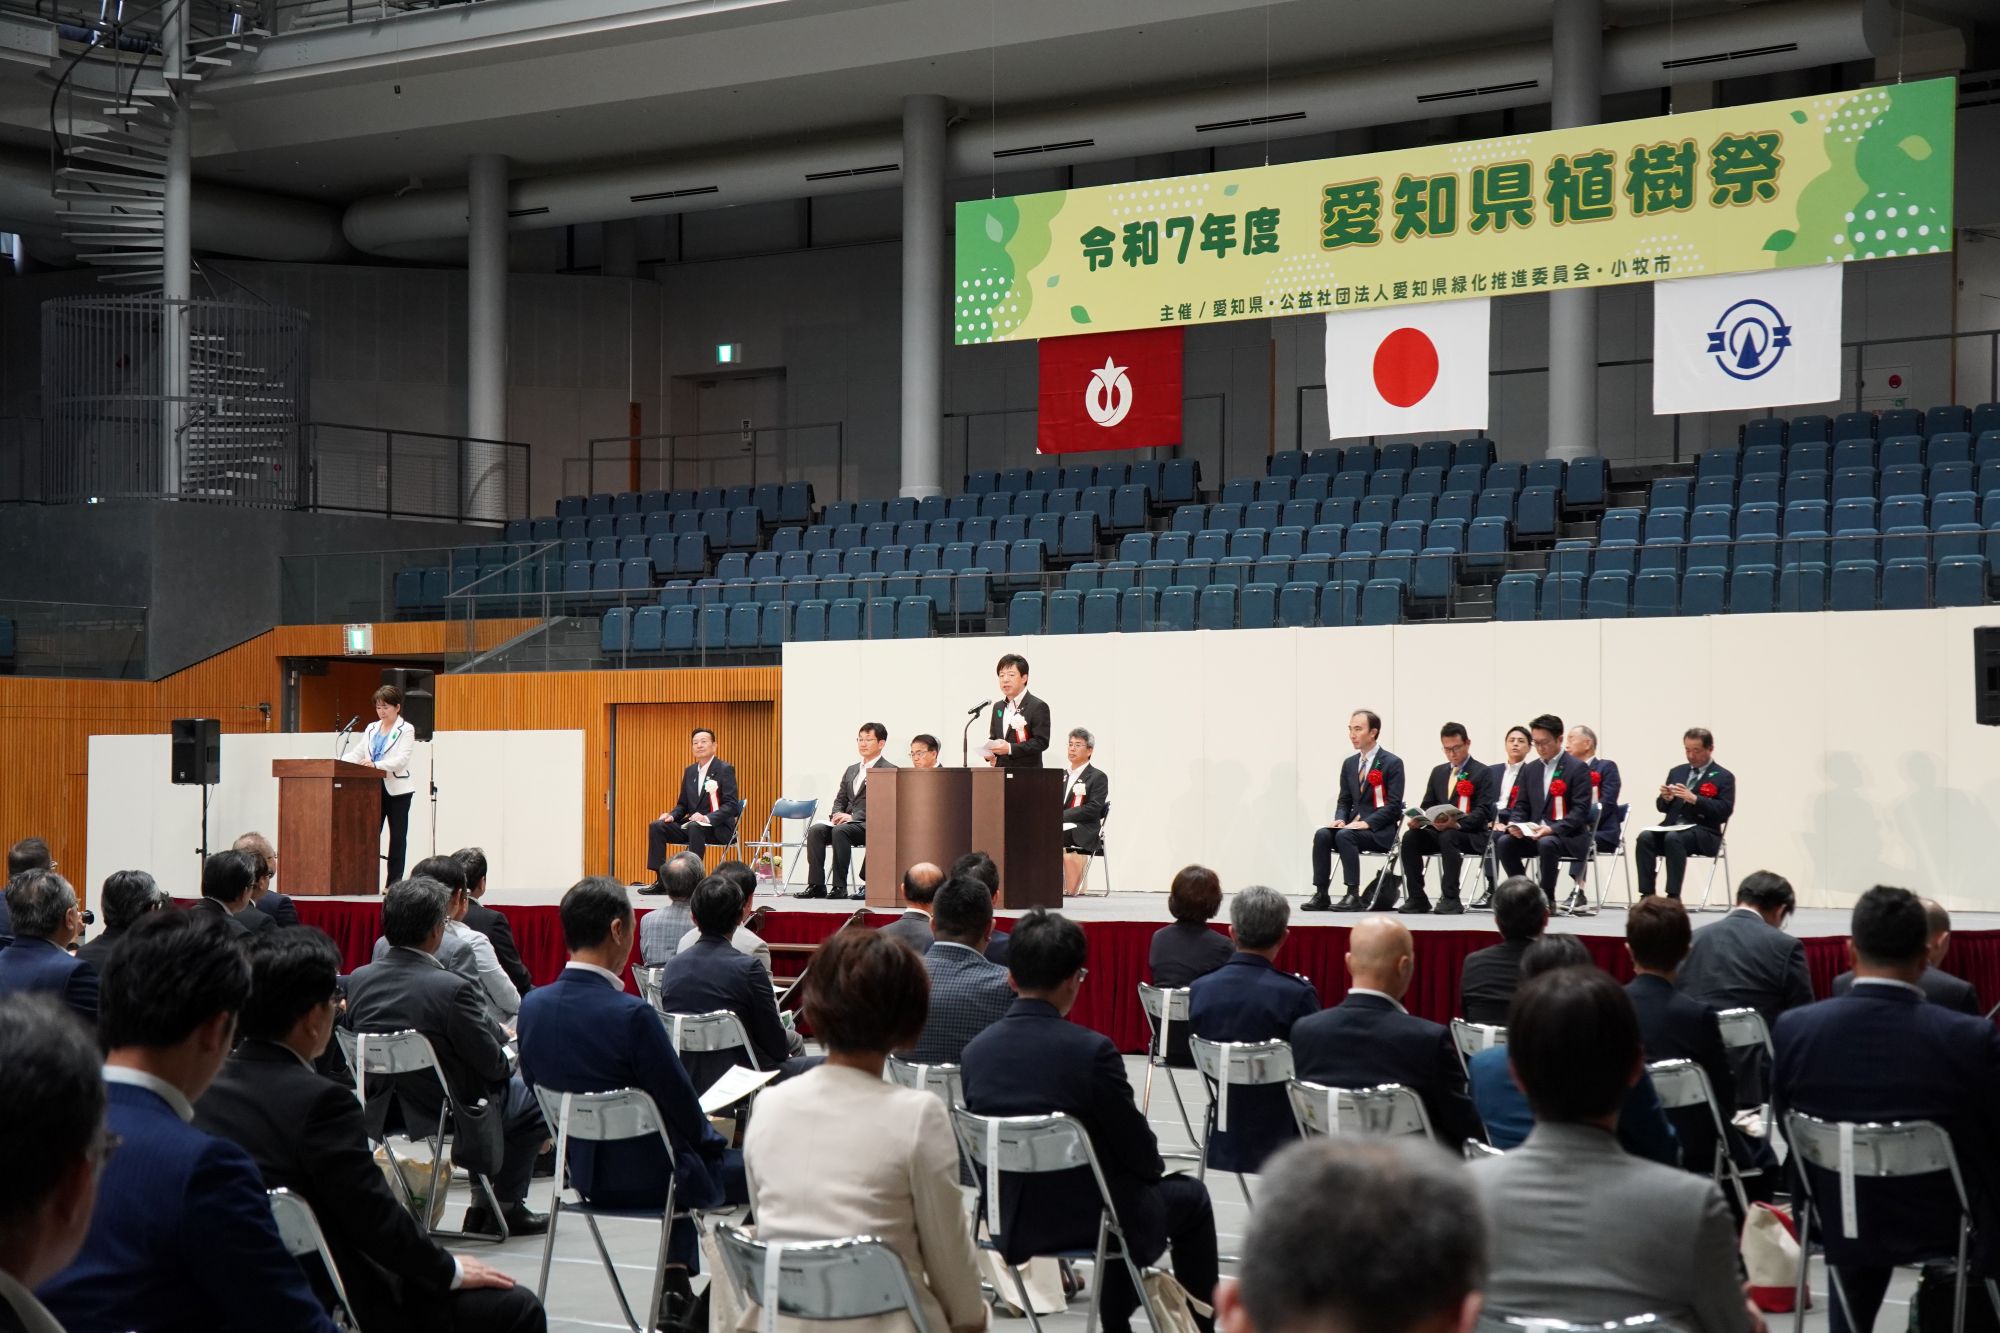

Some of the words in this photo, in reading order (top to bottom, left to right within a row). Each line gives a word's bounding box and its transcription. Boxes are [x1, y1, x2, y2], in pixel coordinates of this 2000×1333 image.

[1080, 207, 1281, 272] 令和7年度
[1322, 131, 1784, 250] 愛知県植樹祭
